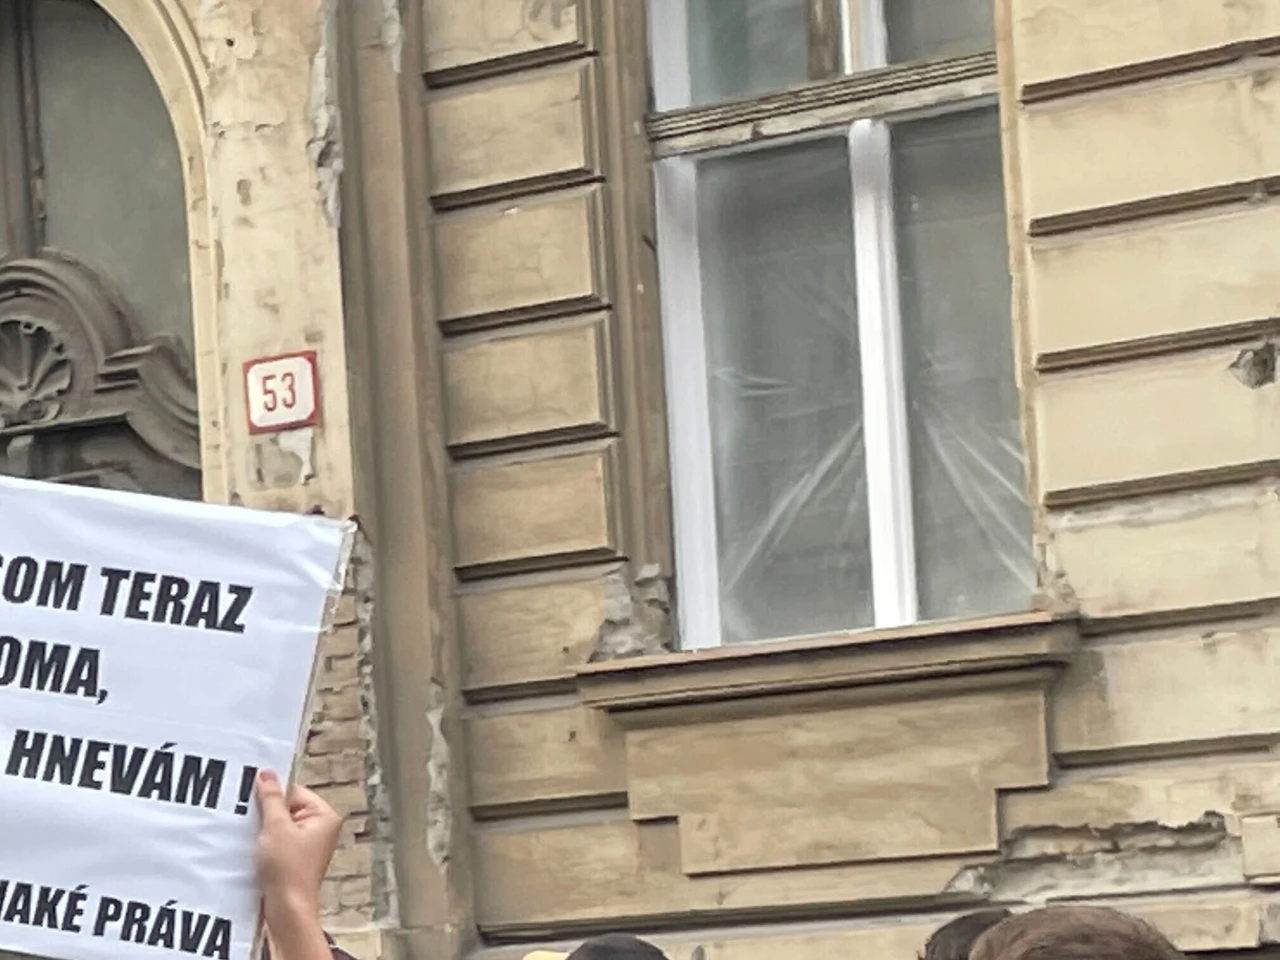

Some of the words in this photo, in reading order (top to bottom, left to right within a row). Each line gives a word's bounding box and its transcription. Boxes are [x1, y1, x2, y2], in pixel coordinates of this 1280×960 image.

[262, 371, 296, 412] 53
[100, 567, 254, 633] TERAZ
[5, 729, 227, 810] HNEVÁM
